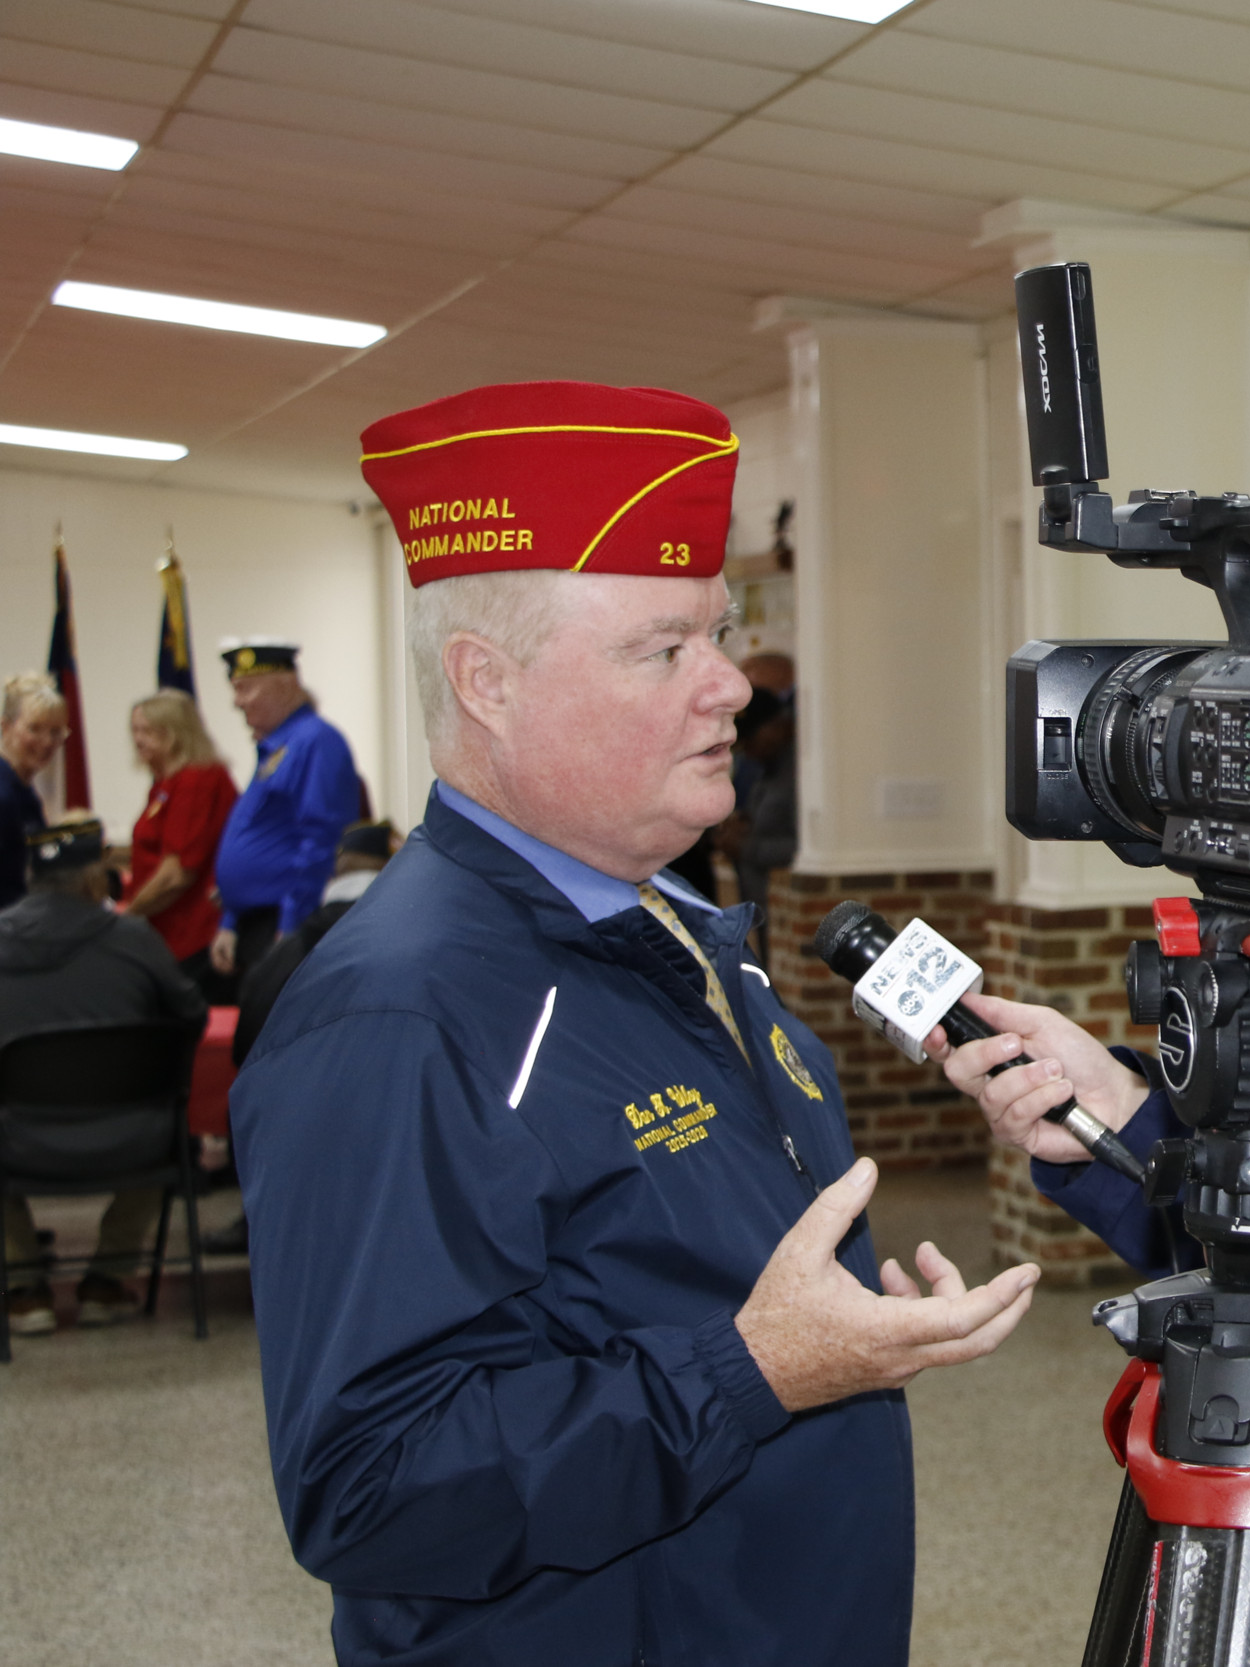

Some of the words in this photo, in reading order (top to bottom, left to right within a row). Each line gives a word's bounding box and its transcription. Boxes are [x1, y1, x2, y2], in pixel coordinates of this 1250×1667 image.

[1033, 323, 1052, 413] XDCAM
[409, 497, 516, 530] NATIONAL
[404, 529, 533, 566] COMMANDER
[659, 542, 691, 566] 23
[905, 946, 962, 995] 12
[634, 1125, 676, 1152] NATIONAL
